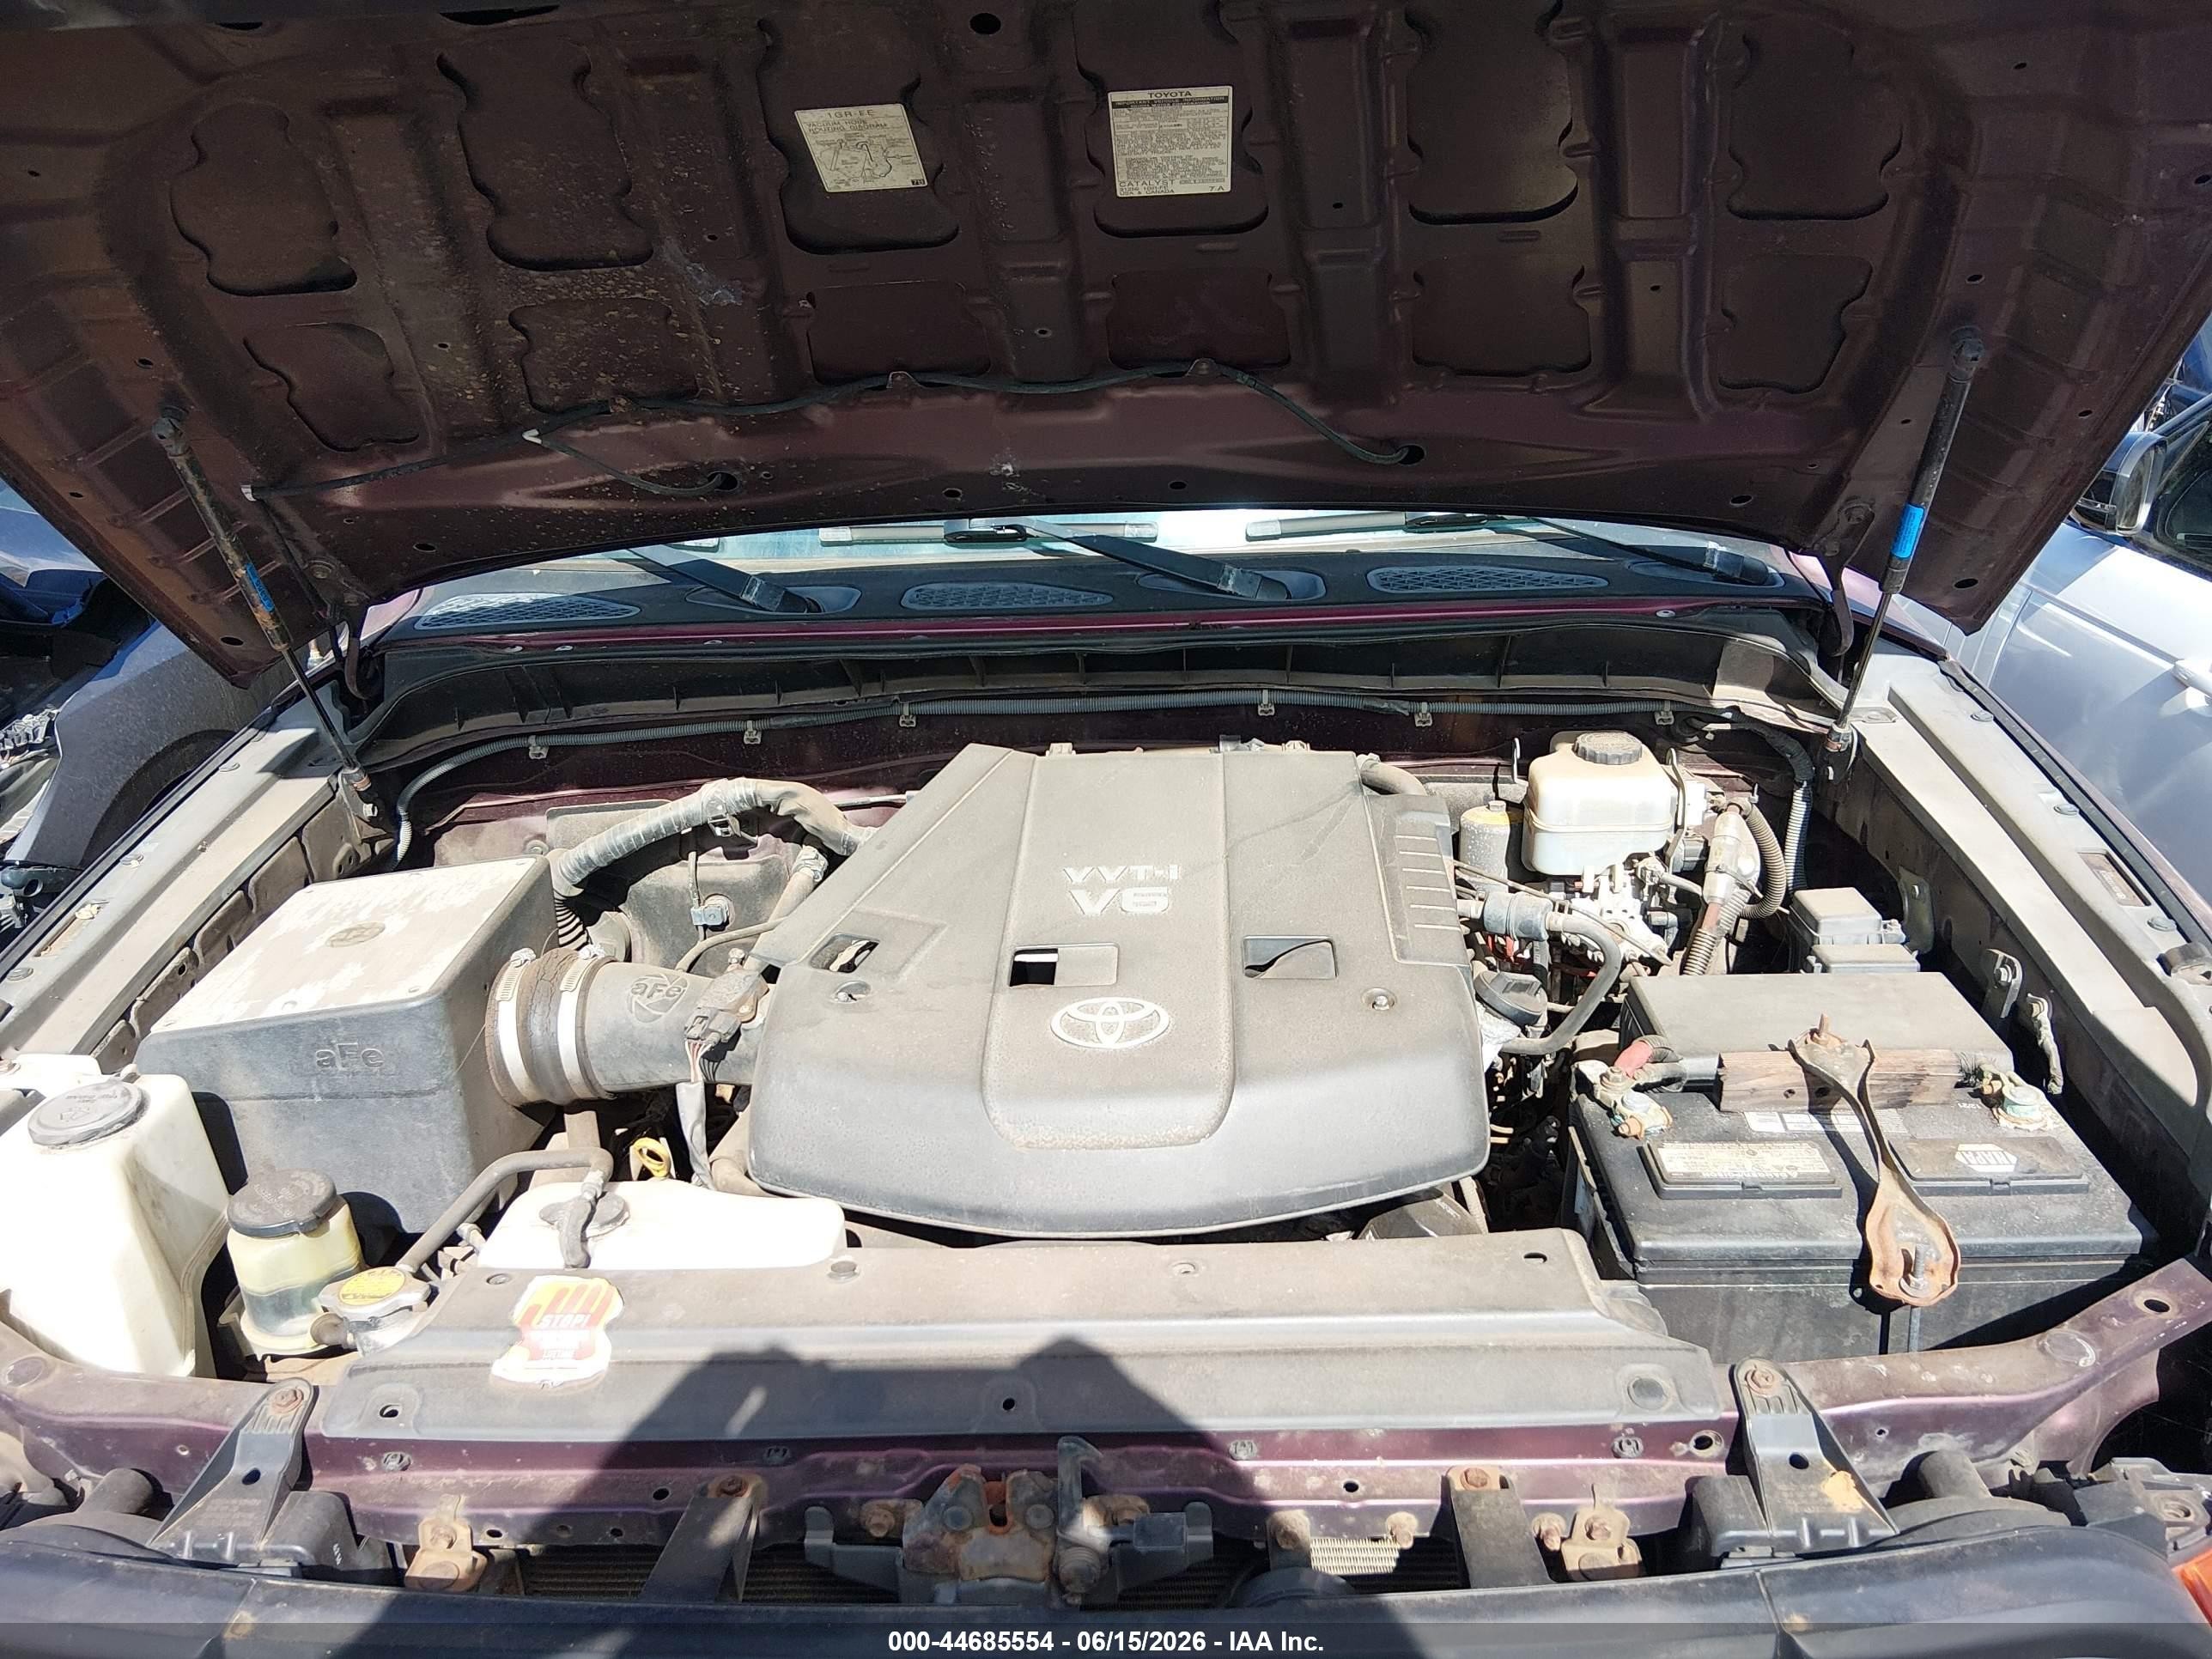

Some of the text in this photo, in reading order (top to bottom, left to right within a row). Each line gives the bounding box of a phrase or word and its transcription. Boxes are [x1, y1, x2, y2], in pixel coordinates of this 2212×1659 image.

[1148, 90, 1192, 99] TOYOTA
[1119, 179, 1175, 188] CATALYST
[1068, 886, 1170, 915] V6
[631, 982, 682, 999] aFe
[315, 1042, 386, 1071] aFe
[1963, 1151, 2009, 1165] NAPA
[538, 1314, 592, 1328] STOP!
